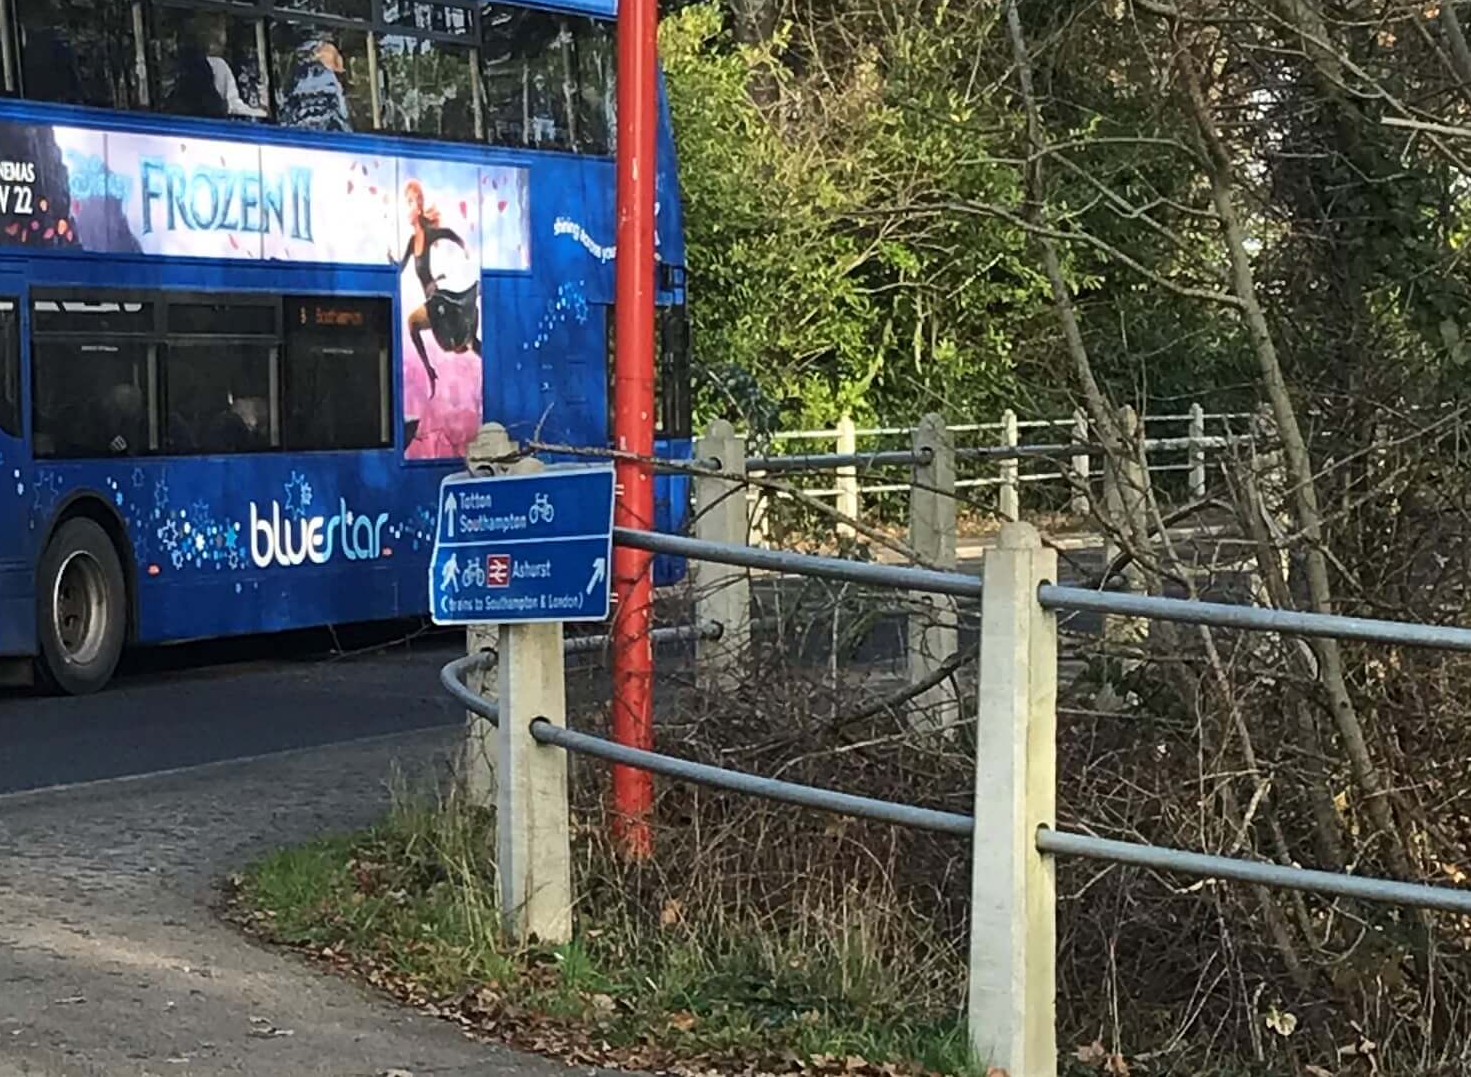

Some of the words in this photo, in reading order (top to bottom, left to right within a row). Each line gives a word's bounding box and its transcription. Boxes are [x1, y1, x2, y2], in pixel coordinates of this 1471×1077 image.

[13, 187, 34, 215] 22
[140, 153, 286, 236] FROZEN
[288, 165, 315, 244] II
[458, 491, 493, 510] Totton
[249, 496, 389, 568] bluestar
[458, 513, 527, 534] Southampton
[512, 559, 551, 579] Ashurst
[484, 595, 538, 612] Southampton
[548, 591, 584, 610] London)
